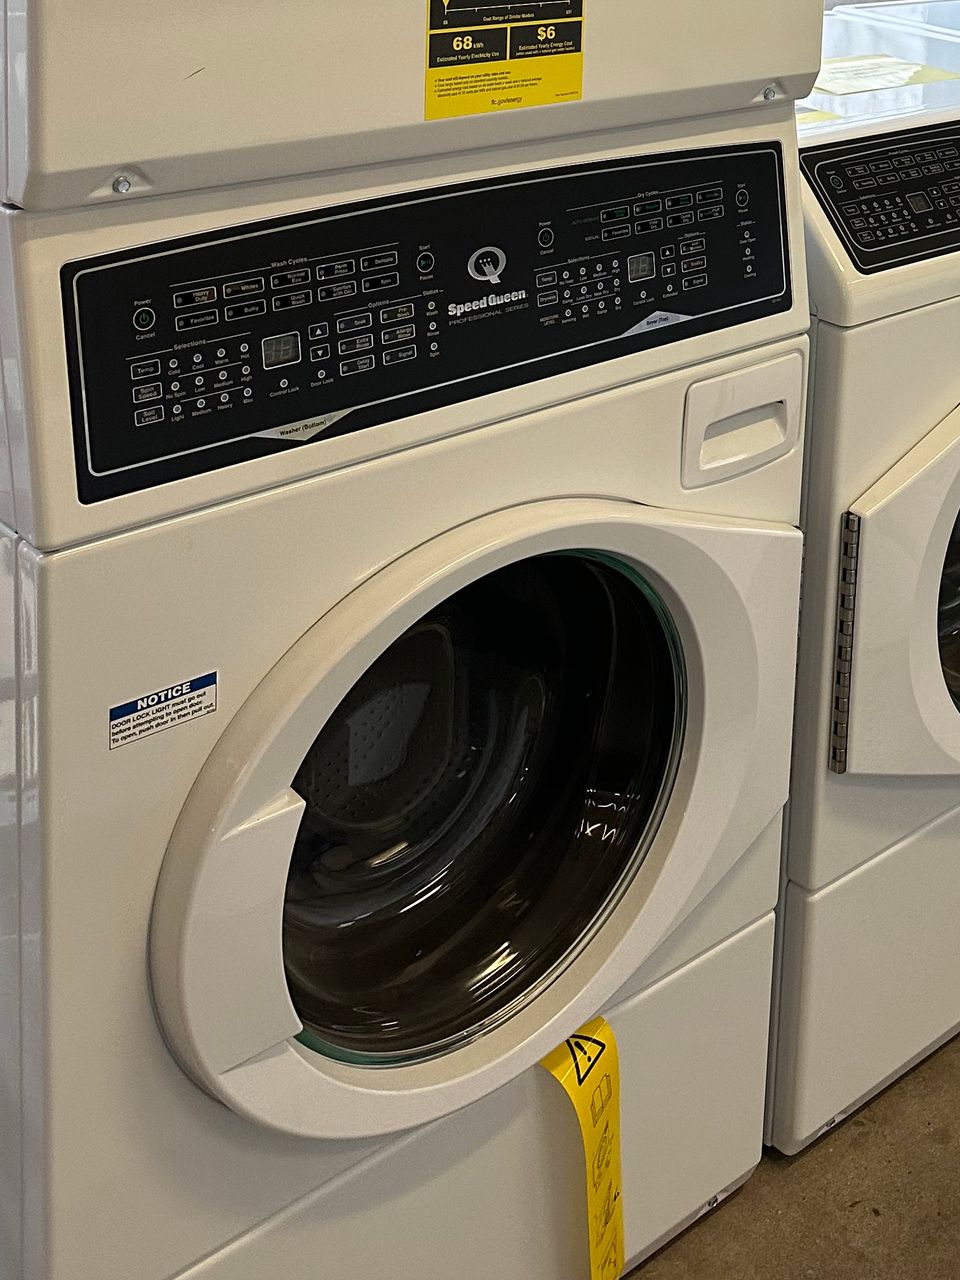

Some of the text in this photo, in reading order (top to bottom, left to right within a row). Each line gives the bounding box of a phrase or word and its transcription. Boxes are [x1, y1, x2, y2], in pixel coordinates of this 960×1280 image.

[538, 26, 555, 41] $6
[453, 36, 473, 51] 68
[271, 257, 307, 268] Wash Cycles
[368, 300, 389, 308] Options
[449, 303, 529, 326] PROFESSIONAL SERIES
[136, 332, 155, 340] Cancel
[174, 340, 207, 350] Selections
[138, 366, 154, 374] Temp
[280, 420, 326, 436] Washer (Bottom)
[137, 682, 191, 710] NOTICE
[112, 719, 131, 730] DOOR
[132, 711, 151, 723] LOCK
[152, 704, 170, 715] LIGHT
[172, 700, 187, 708] must
[112, 725, 131, 737] before
[133, 714, 165, 729] attempting
[173, 706, 188, 714] open
[139, 725, 154, 735] push
[155, 719, 168, 728] door
[191, 707, 203, 716] pull
